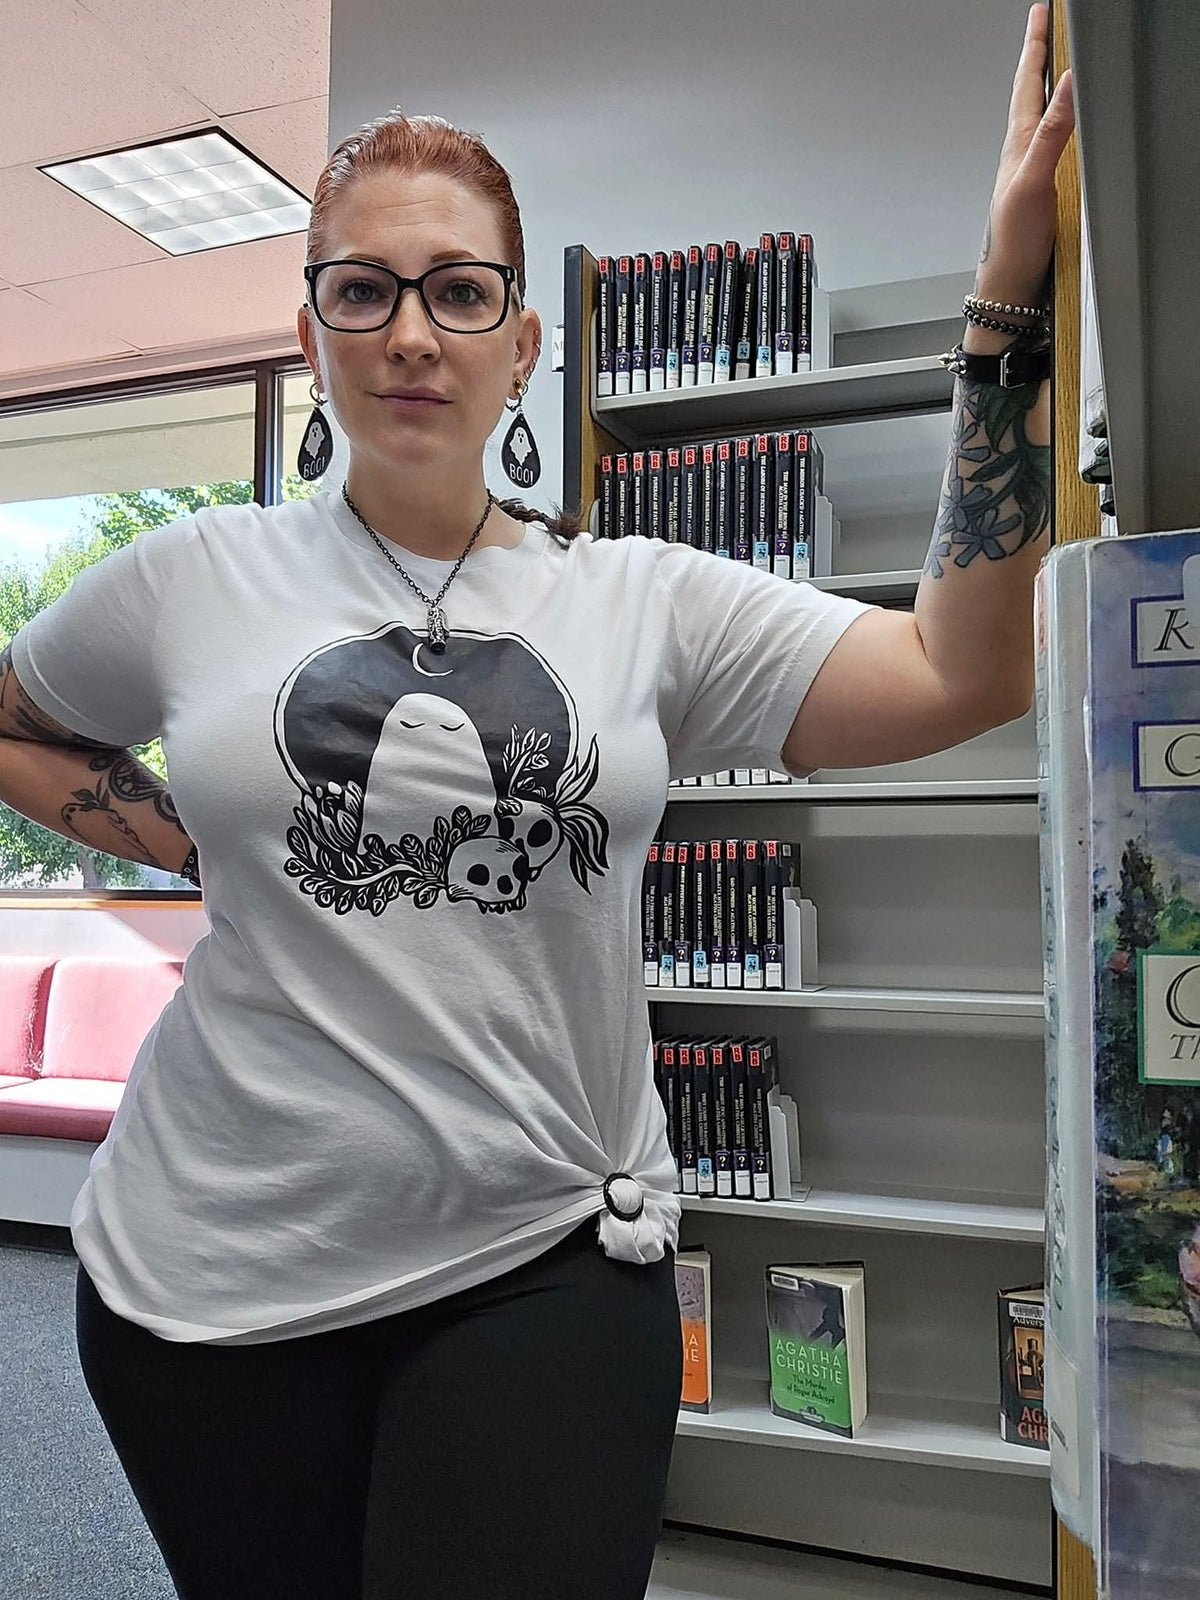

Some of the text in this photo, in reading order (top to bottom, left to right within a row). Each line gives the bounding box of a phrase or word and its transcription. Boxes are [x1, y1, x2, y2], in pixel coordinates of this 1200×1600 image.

[303, 456, 325, 478] BOO!
[509, 463, 534, 486] BOO!
[776, 1339, 842, 1368] AGATHA
[776, 1354, 842, 1384] CHRISTIE
[1022, 1406, 1047, 1425] AG
